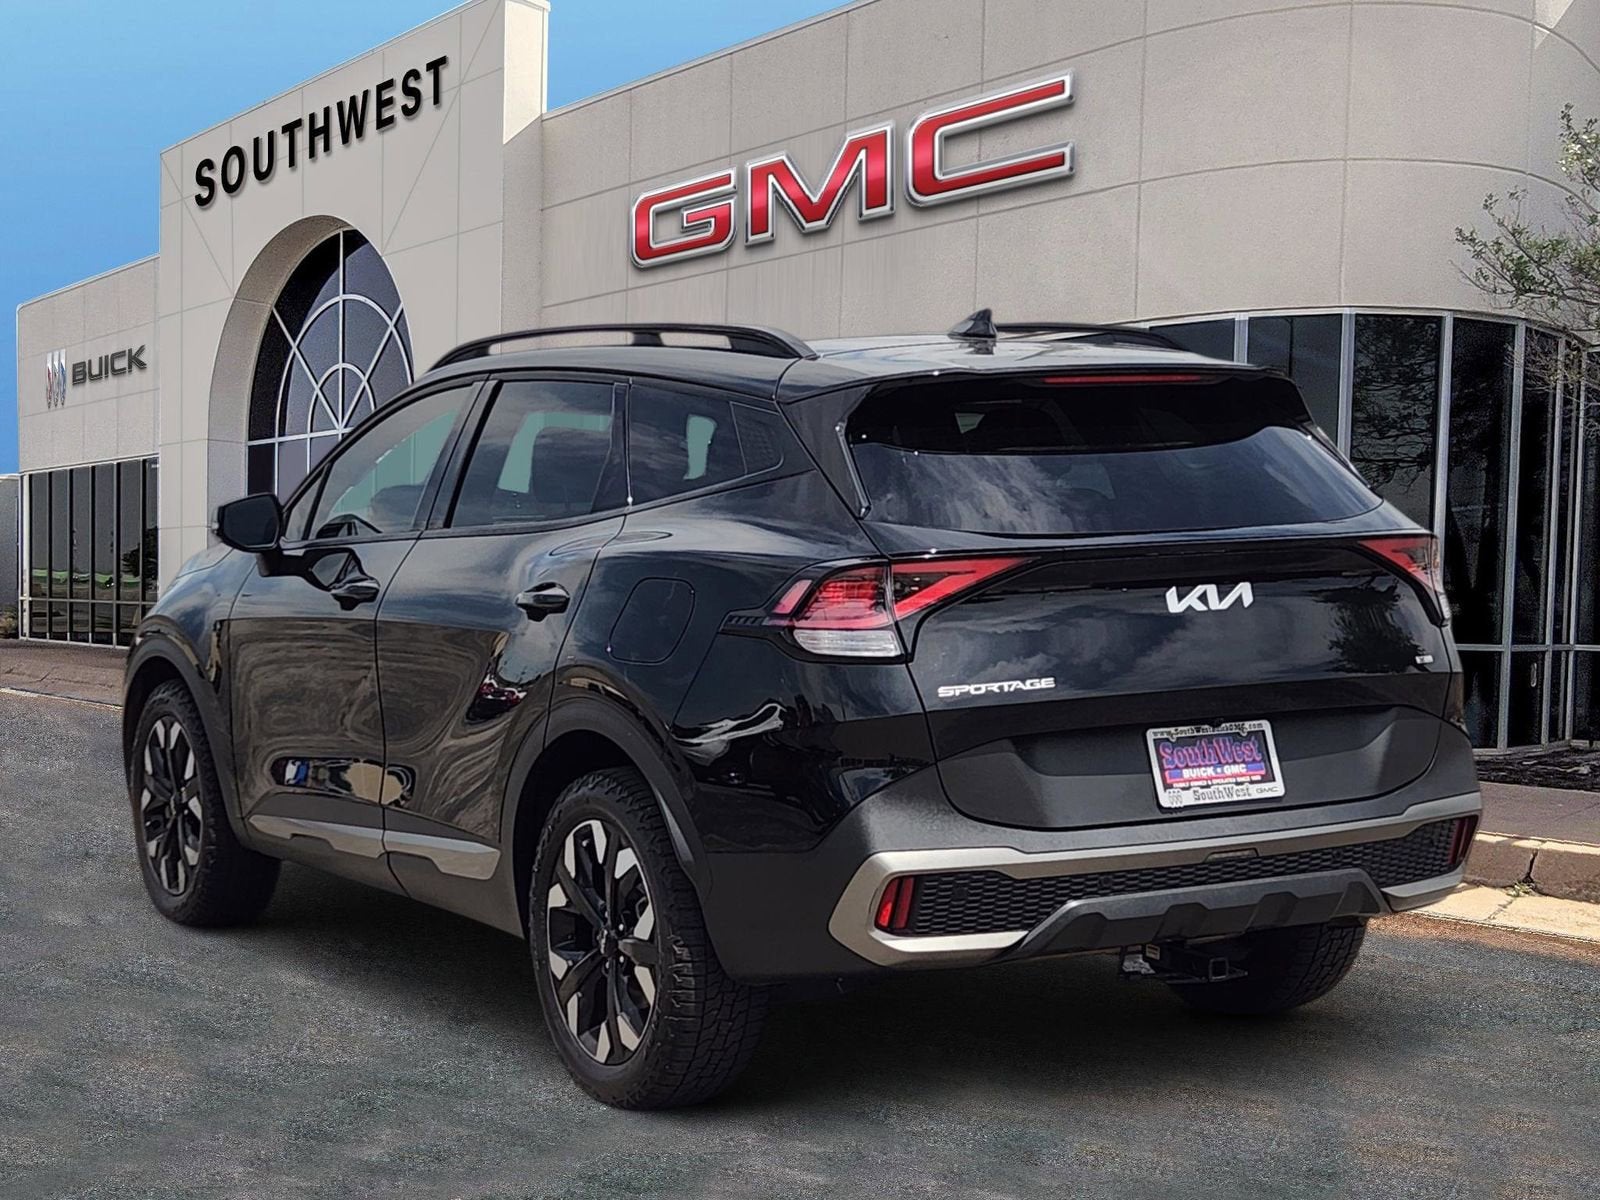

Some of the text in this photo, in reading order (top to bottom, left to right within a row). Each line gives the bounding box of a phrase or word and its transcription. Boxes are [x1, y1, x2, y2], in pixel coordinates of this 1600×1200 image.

[194, 55, 448, 207] SOUTHWEST
[630, 68, 1076, 268] GMC
[71, 345, 148, 387] BUICK
[1165, 581, 1254, 614] KIA
[937, 676, 1056, 699] SPORTAGE
[1160, 736, 1262, 768] SouthWest
[1182, 763, 1248, 779] BUICK GMC
[1192, 785, 1279, 802] SouthWest GMC
